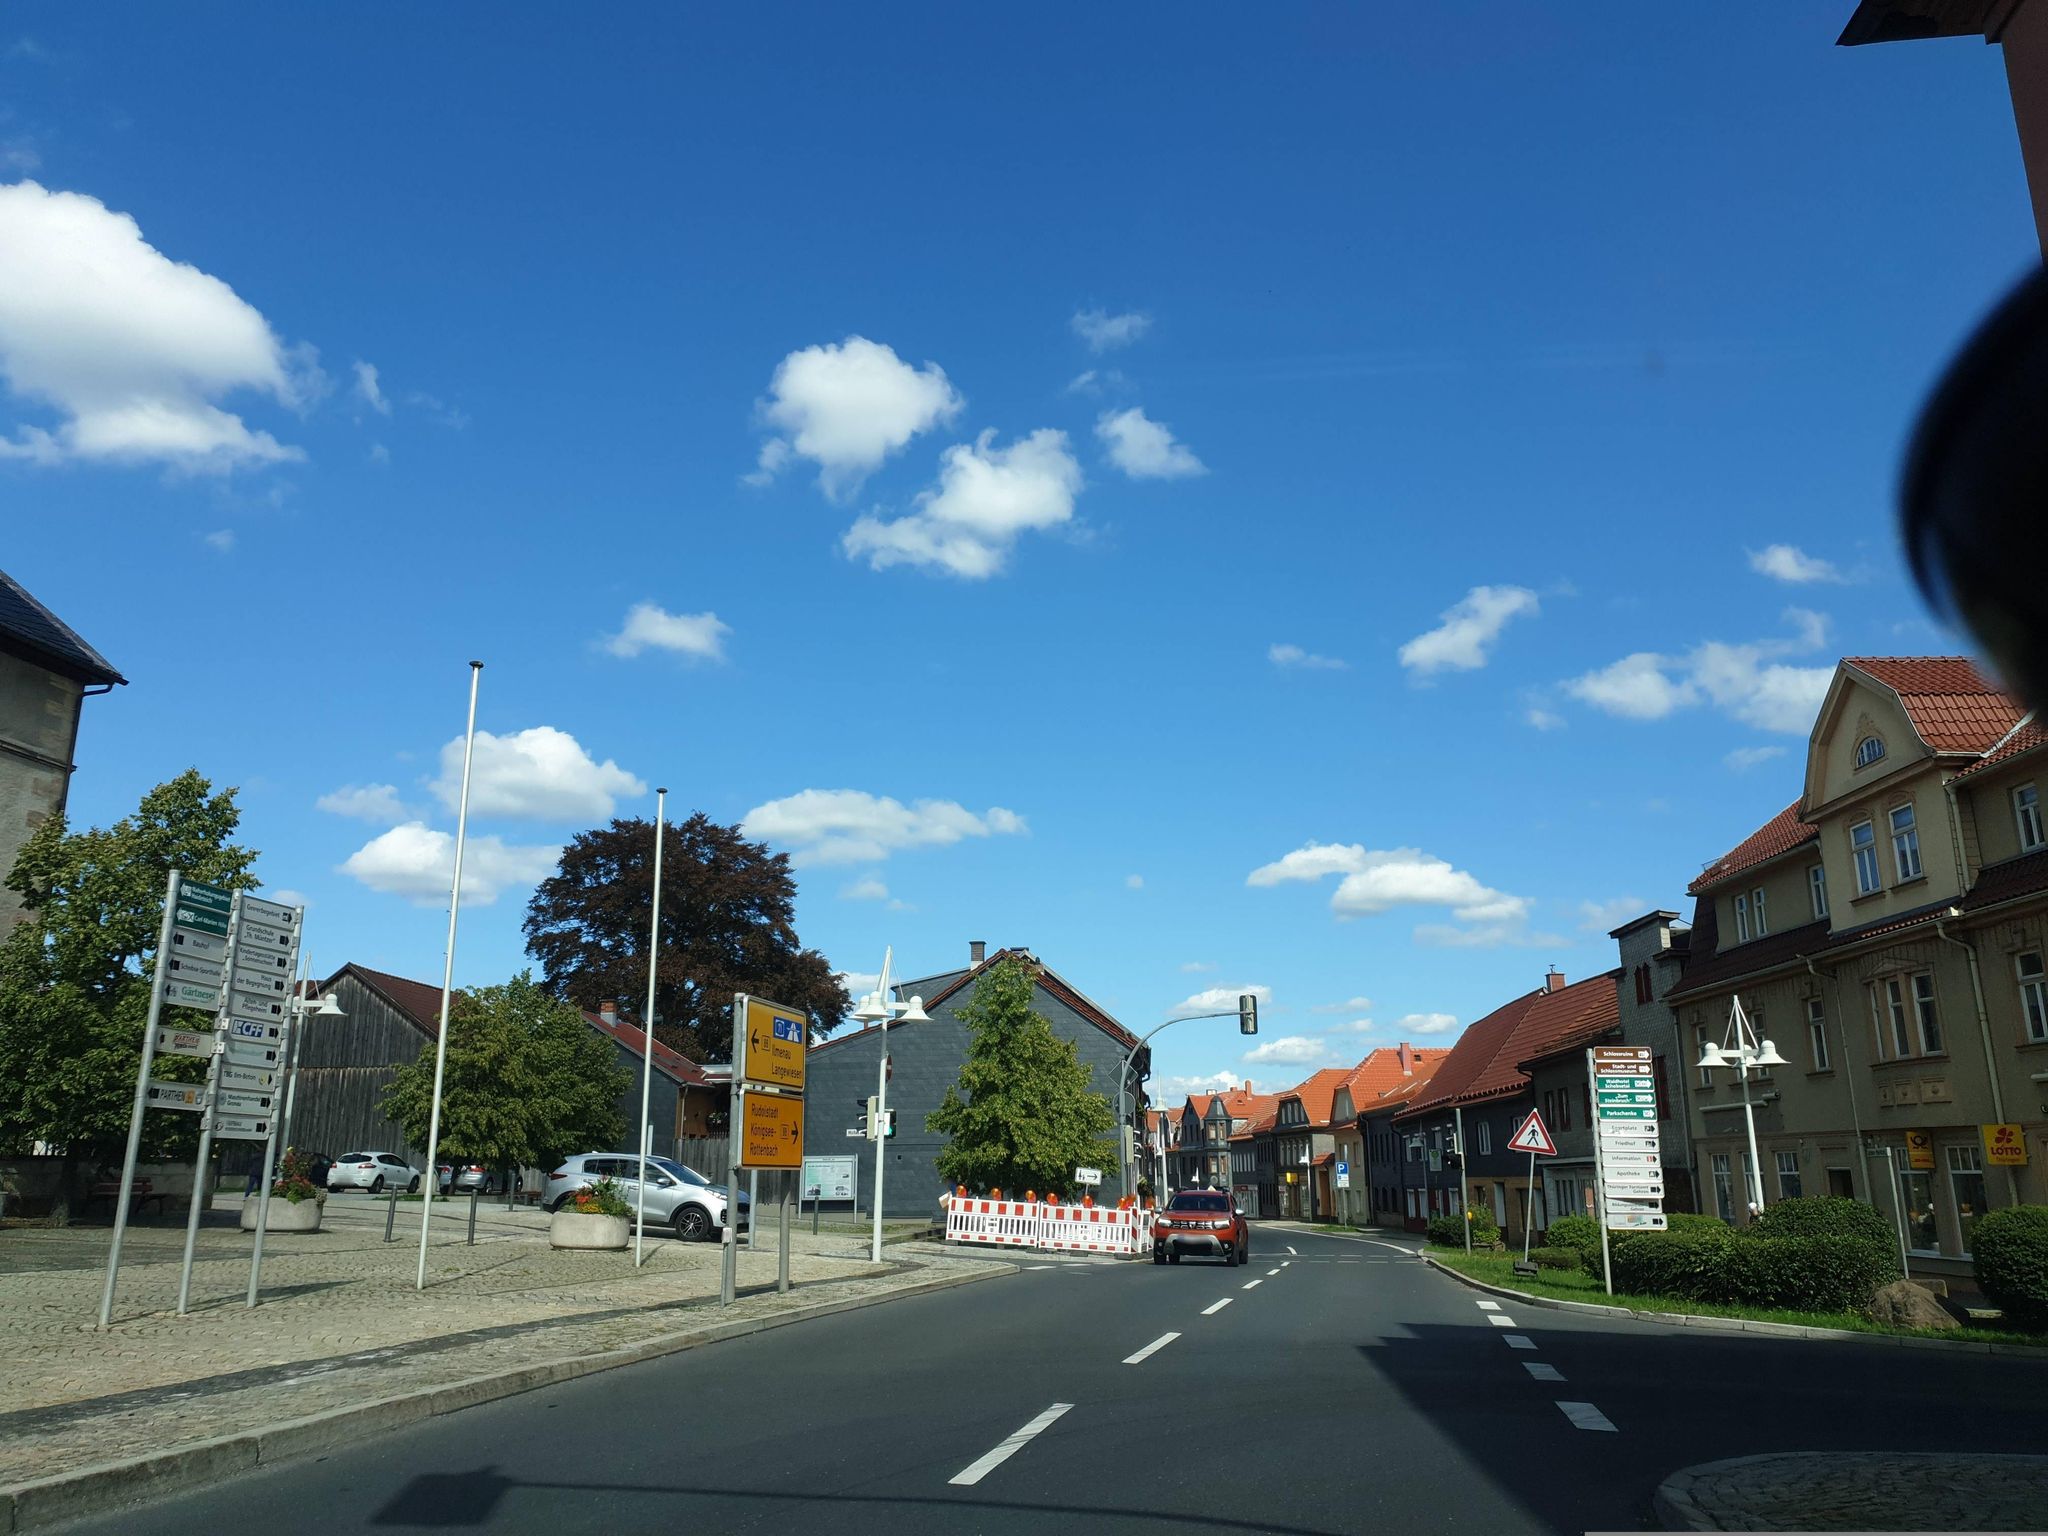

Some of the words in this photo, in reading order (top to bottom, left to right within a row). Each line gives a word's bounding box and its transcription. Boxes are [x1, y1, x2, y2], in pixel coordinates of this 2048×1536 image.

[246, 924, 275, 937] Grundschule
[192, 940, 210, 950] Bauhof
[245, 978, 272, 990] Begegnung
[181, 986, 216, 1000] Gärtnerei
[771, 1043, 791, 1060] Ilmenau
[751, 1103, 779, 1119] Rudolstadt
[750, 1122, 777, 1140] Königsee-
[749, 1142, 778, 1157] Rottenbach
[1991, 1147, 2022, 1155] LOTTO
[1338, 1164, 1345, 1174] P
